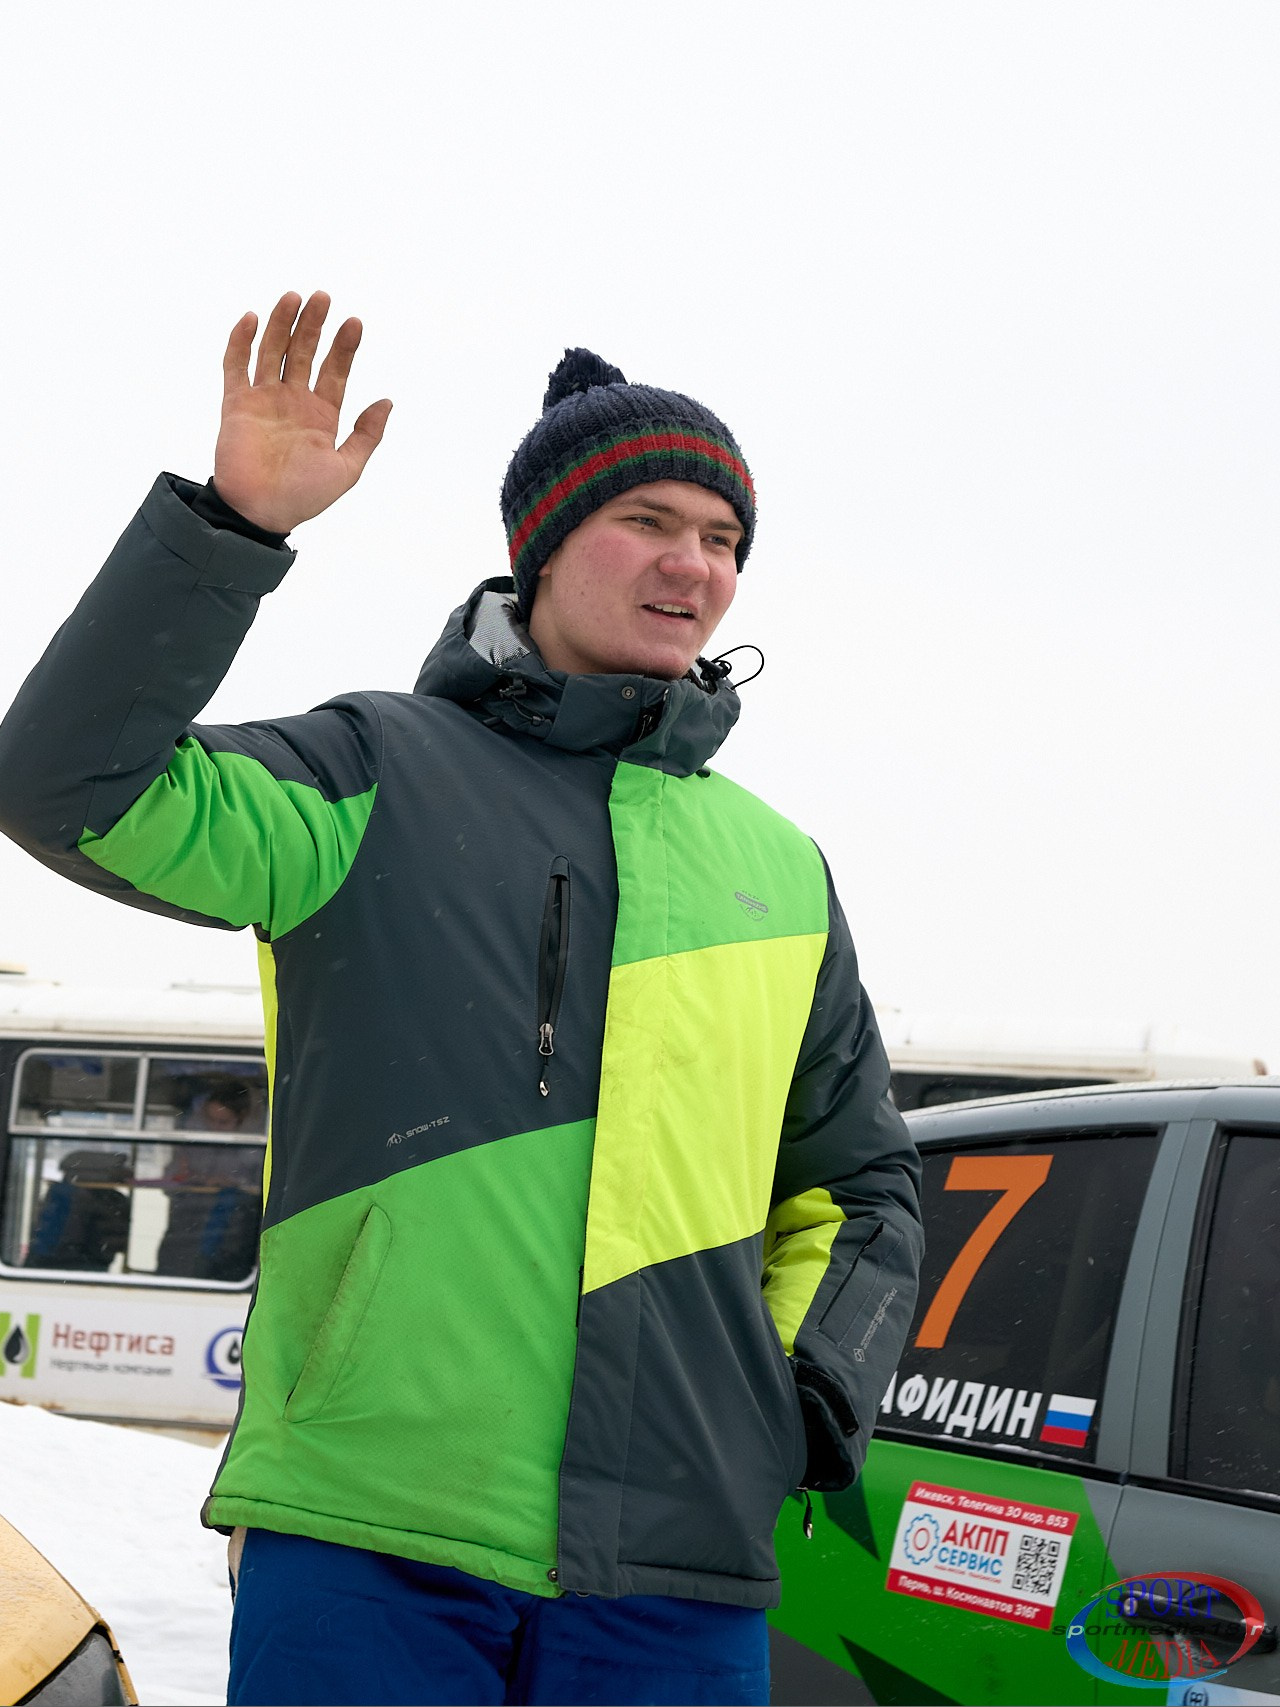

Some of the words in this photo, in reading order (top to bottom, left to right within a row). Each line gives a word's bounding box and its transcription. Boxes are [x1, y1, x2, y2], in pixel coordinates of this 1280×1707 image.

[914, 1154, 1054, 1348] 7
[52, 1324, 175, 1357] Нефтиса
[914, 1487, 955, 1506] Ижевск,
[958, 1495, 1004, 1515] Телегина
[1005, 1505, 1022, 1518] 30
[1022, 1511, 1044, 1525] кор.
[942, 1519, 1010, 1556] АКПП
[937, 1546, 1003, 1576] СЕРВИС
[946, 1586, 1013, 1614] Космонавтов
